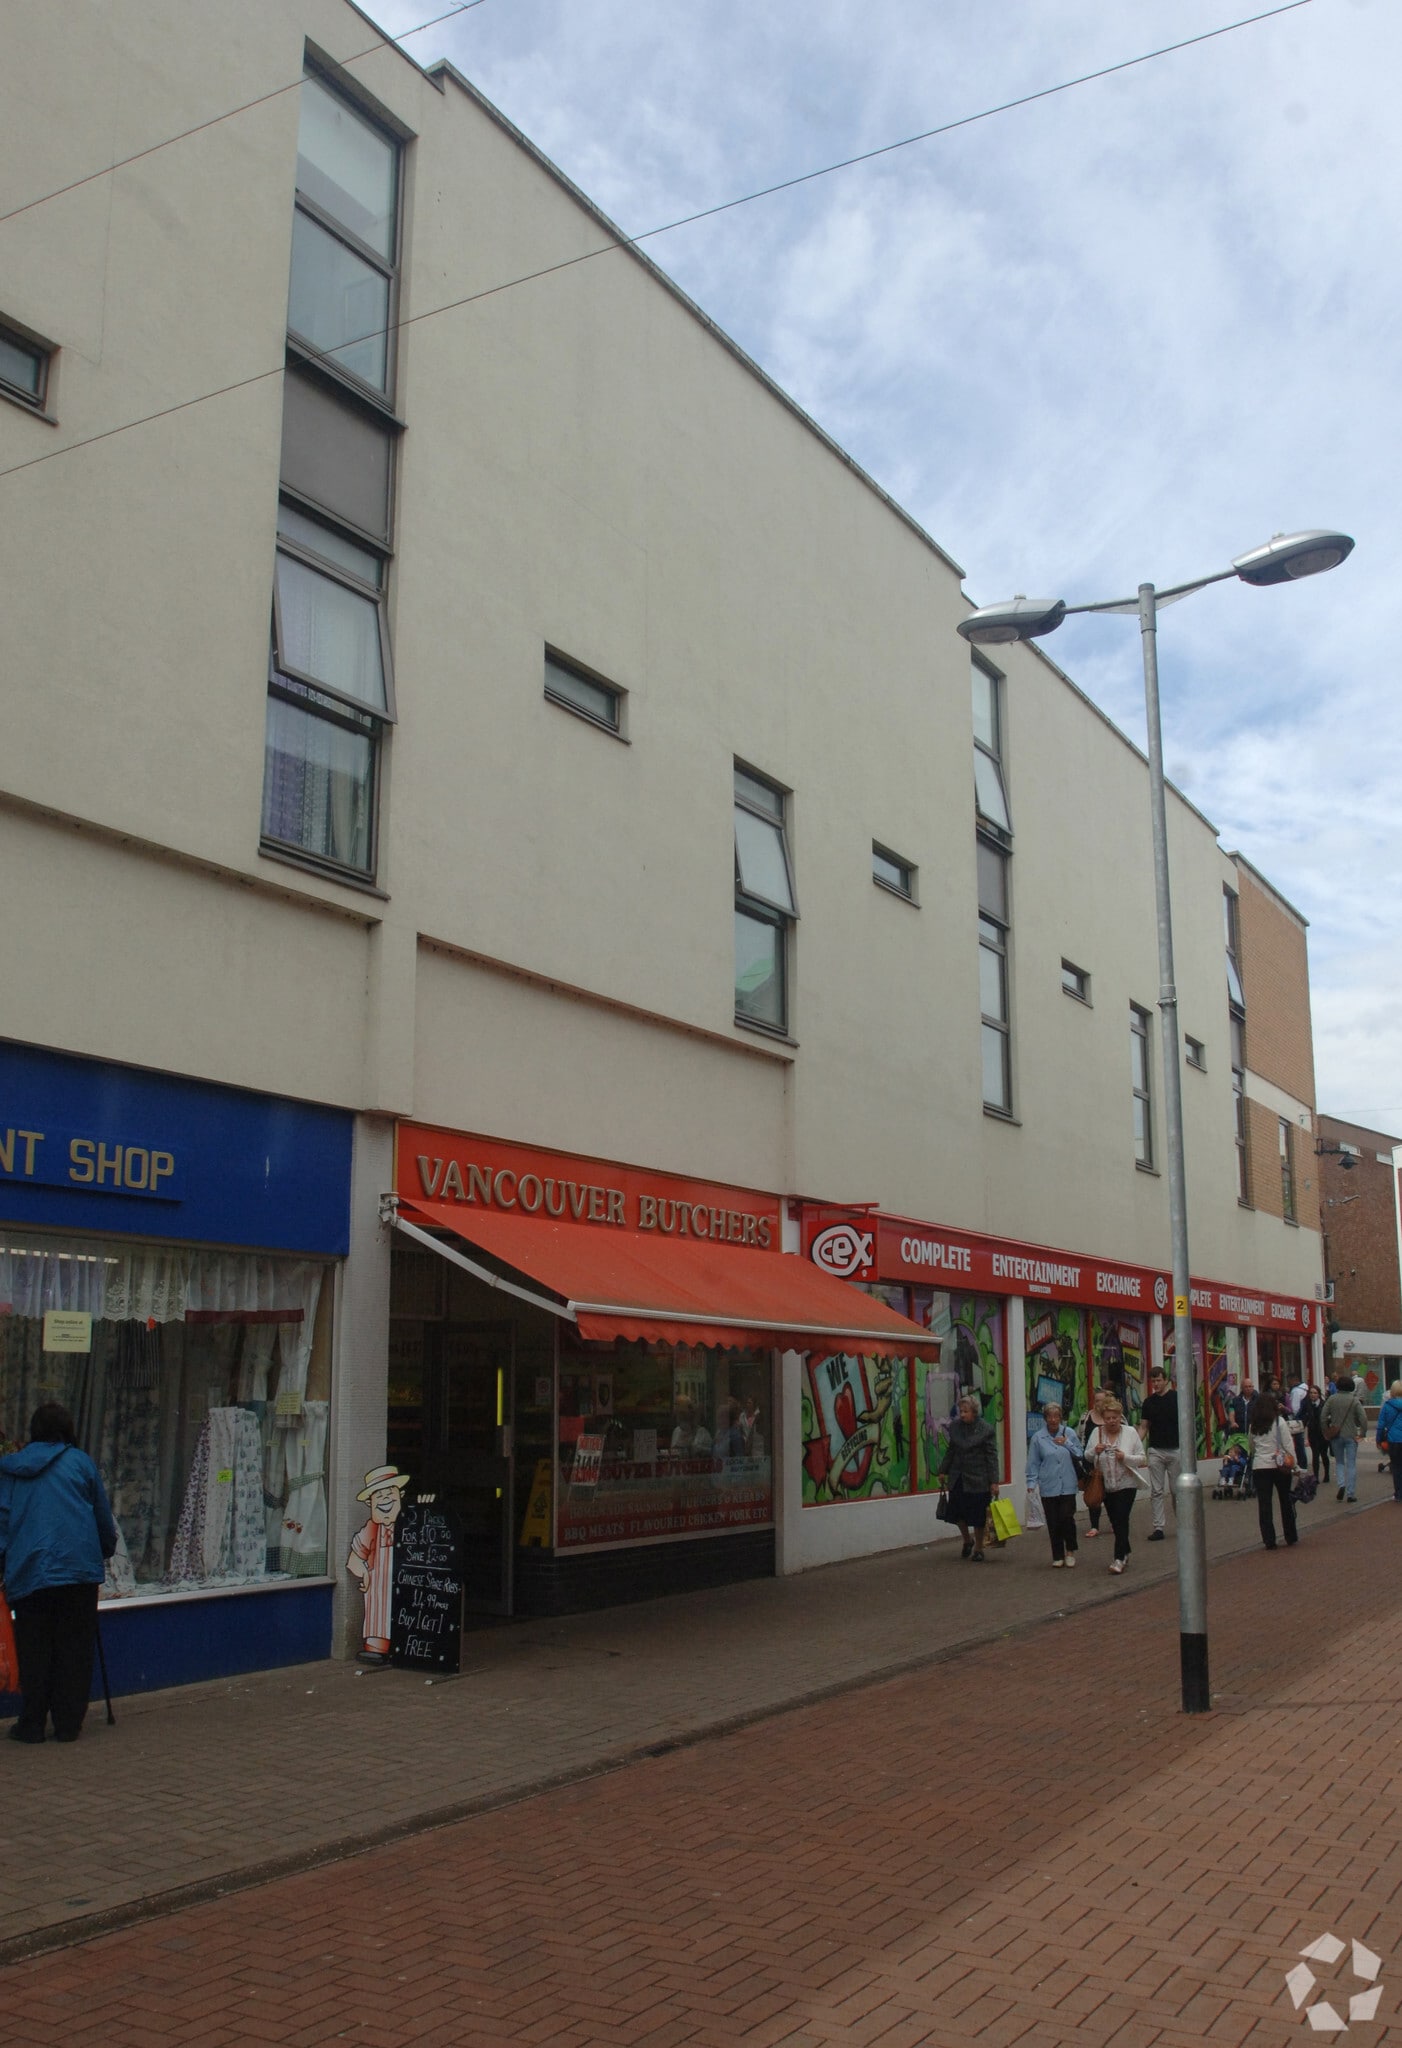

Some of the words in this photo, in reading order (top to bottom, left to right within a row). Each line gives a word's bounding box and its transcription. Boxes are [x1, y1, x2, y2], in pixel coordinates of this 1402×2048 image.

[69, 1138, 175, 1192] SHOP
[417, 1155, 626, 1225] VANCOUVER
[639, 1195, 772, 1248] BUTCHERS
[901, 1237, 971, 1271] COMPLETE
[992, 1253, 1080, 1288] ENTERTAINMENT
[1096, 1272, 1141, 1297] EXCHANGE
[1177, 1300, 1185, 1310] 2
[1219, 1293, 1265, 1316] ENTERTAINMENT
[1271, 1303, 1296, 1321] EXCHANGE
[826, 1353, 849, 1391] WE
[841, 1428, 868, 1462] RECYCLING
[564, 1526, 586, 1542] BBQ
[589, 1521, 625, 1538] MEATS
[630, 1514, 686, 1534] FLAVOURED
[688, 1510, 726, 1526] CHICKEN
[729, 1507, 751, 1521] PORK
[752, 1507, 768, 1520] ETC
[404, 1634, 435, 1659] FREE
